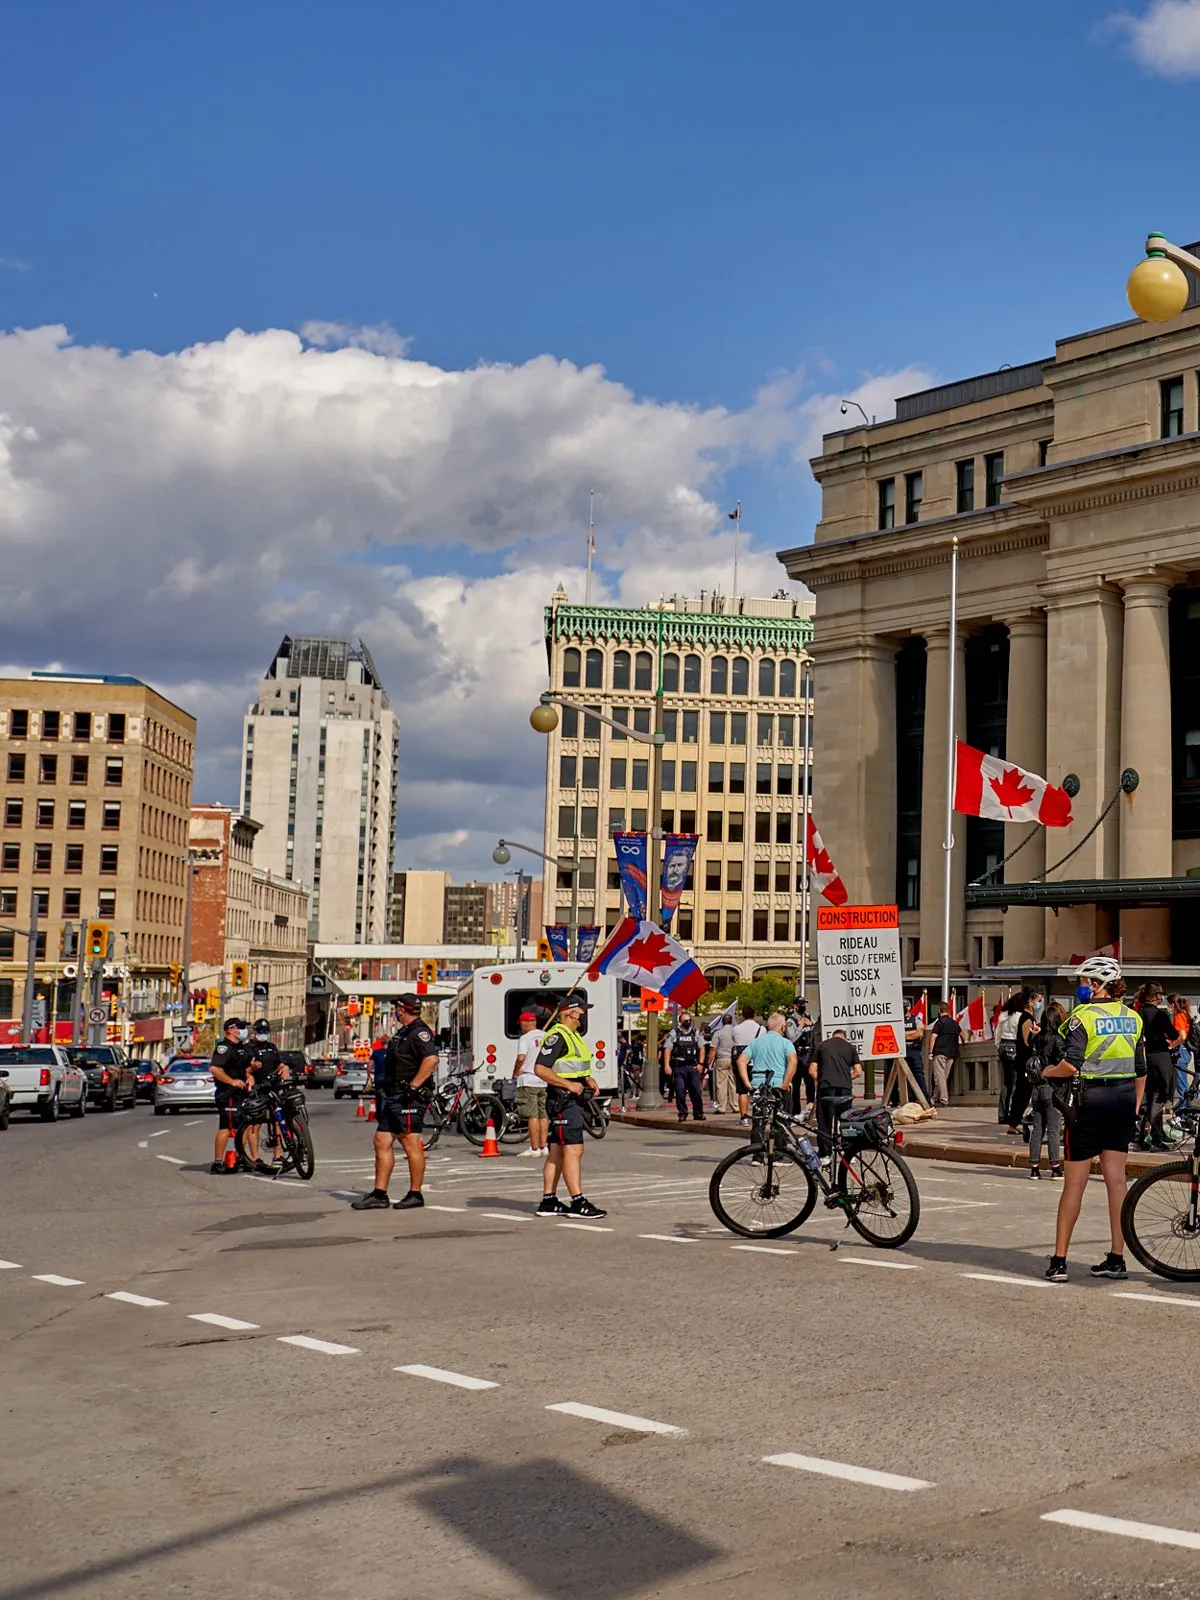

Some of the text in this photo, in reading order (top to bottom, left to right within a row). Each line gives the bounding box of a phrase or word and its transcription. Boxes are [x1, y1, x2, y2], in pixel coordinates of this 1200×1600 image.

[819, 910, 897, 925] CONSTRUCTION
[839, 936, 878, 950] RIDEAU
[824, 950, 897, 966] CLOSED / FERMÉ
[840, 968, 881, 982] SUSSEX
[850, 985, 877, 998] TO / À
[833, 1002, 892, 1018] DALHOUSIE
[1097, 1018, 1137, 1034] POLICE
[826, 1028, 864, 1043] FOW
[877, 1042, 895, 1053] D-2
